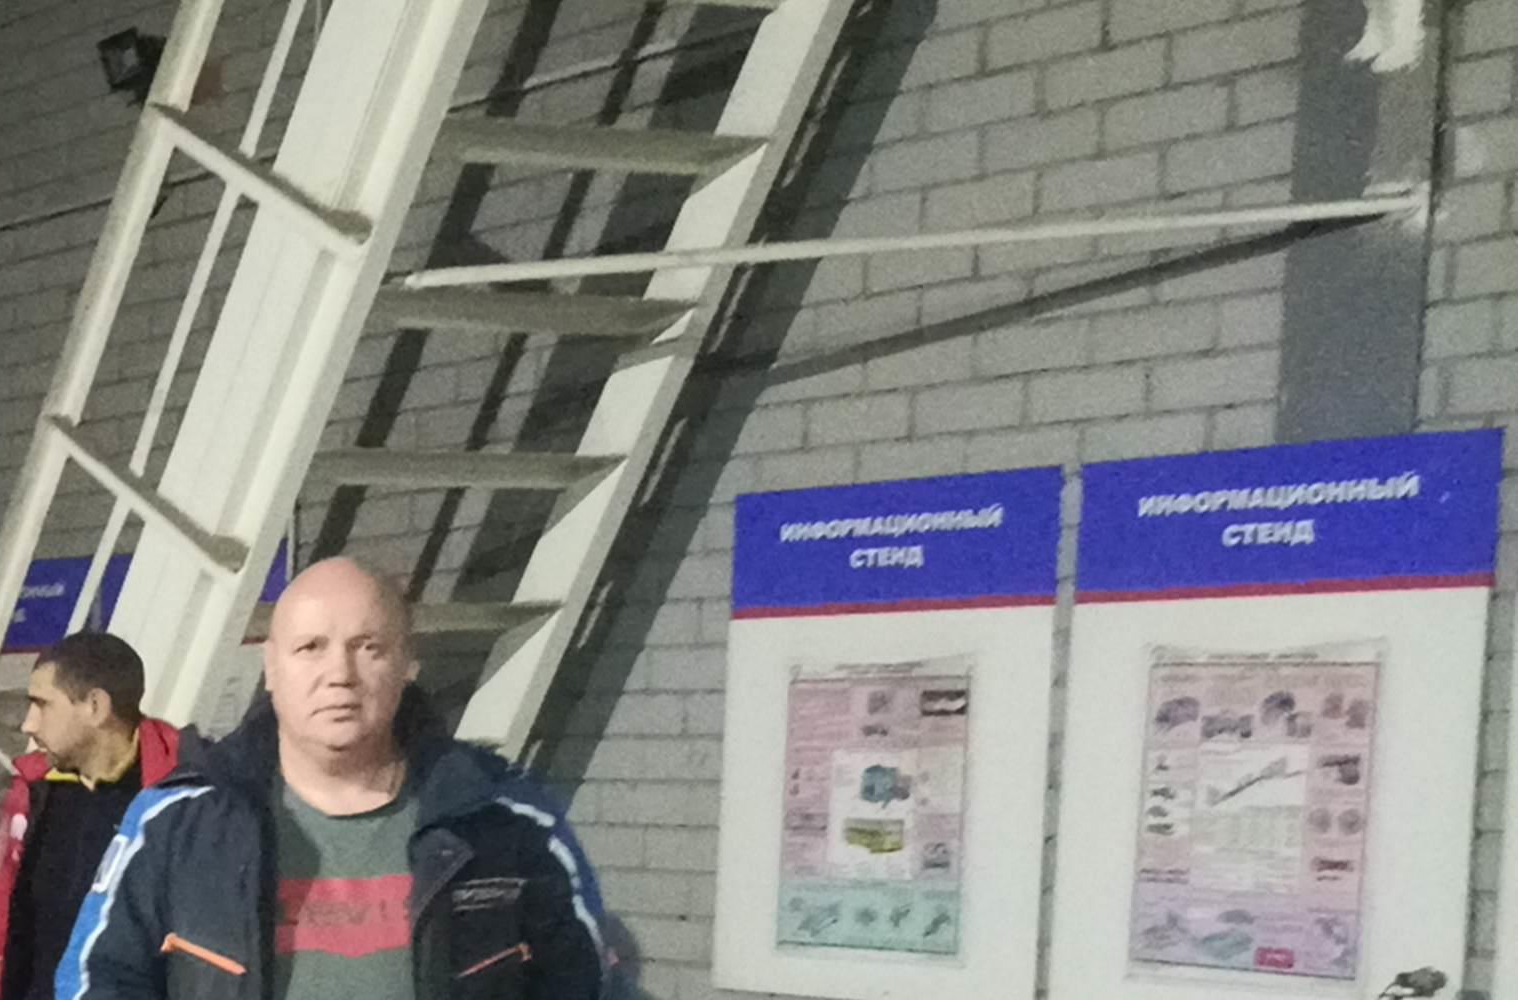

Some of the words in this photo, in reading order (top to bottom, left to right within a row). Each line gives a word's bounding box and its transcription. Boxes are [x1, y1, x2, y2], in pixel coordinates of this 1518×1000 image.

[1137, 470, 1422, 518] ИНФОРМАЦИОННЫЙ
[779, 503, 1005, 543] ИНФОРМАЦИОННЫЙ
[1220, 518, 1316, 548] СТЕНД
[849, 545, 926, 569] СТЕНД
